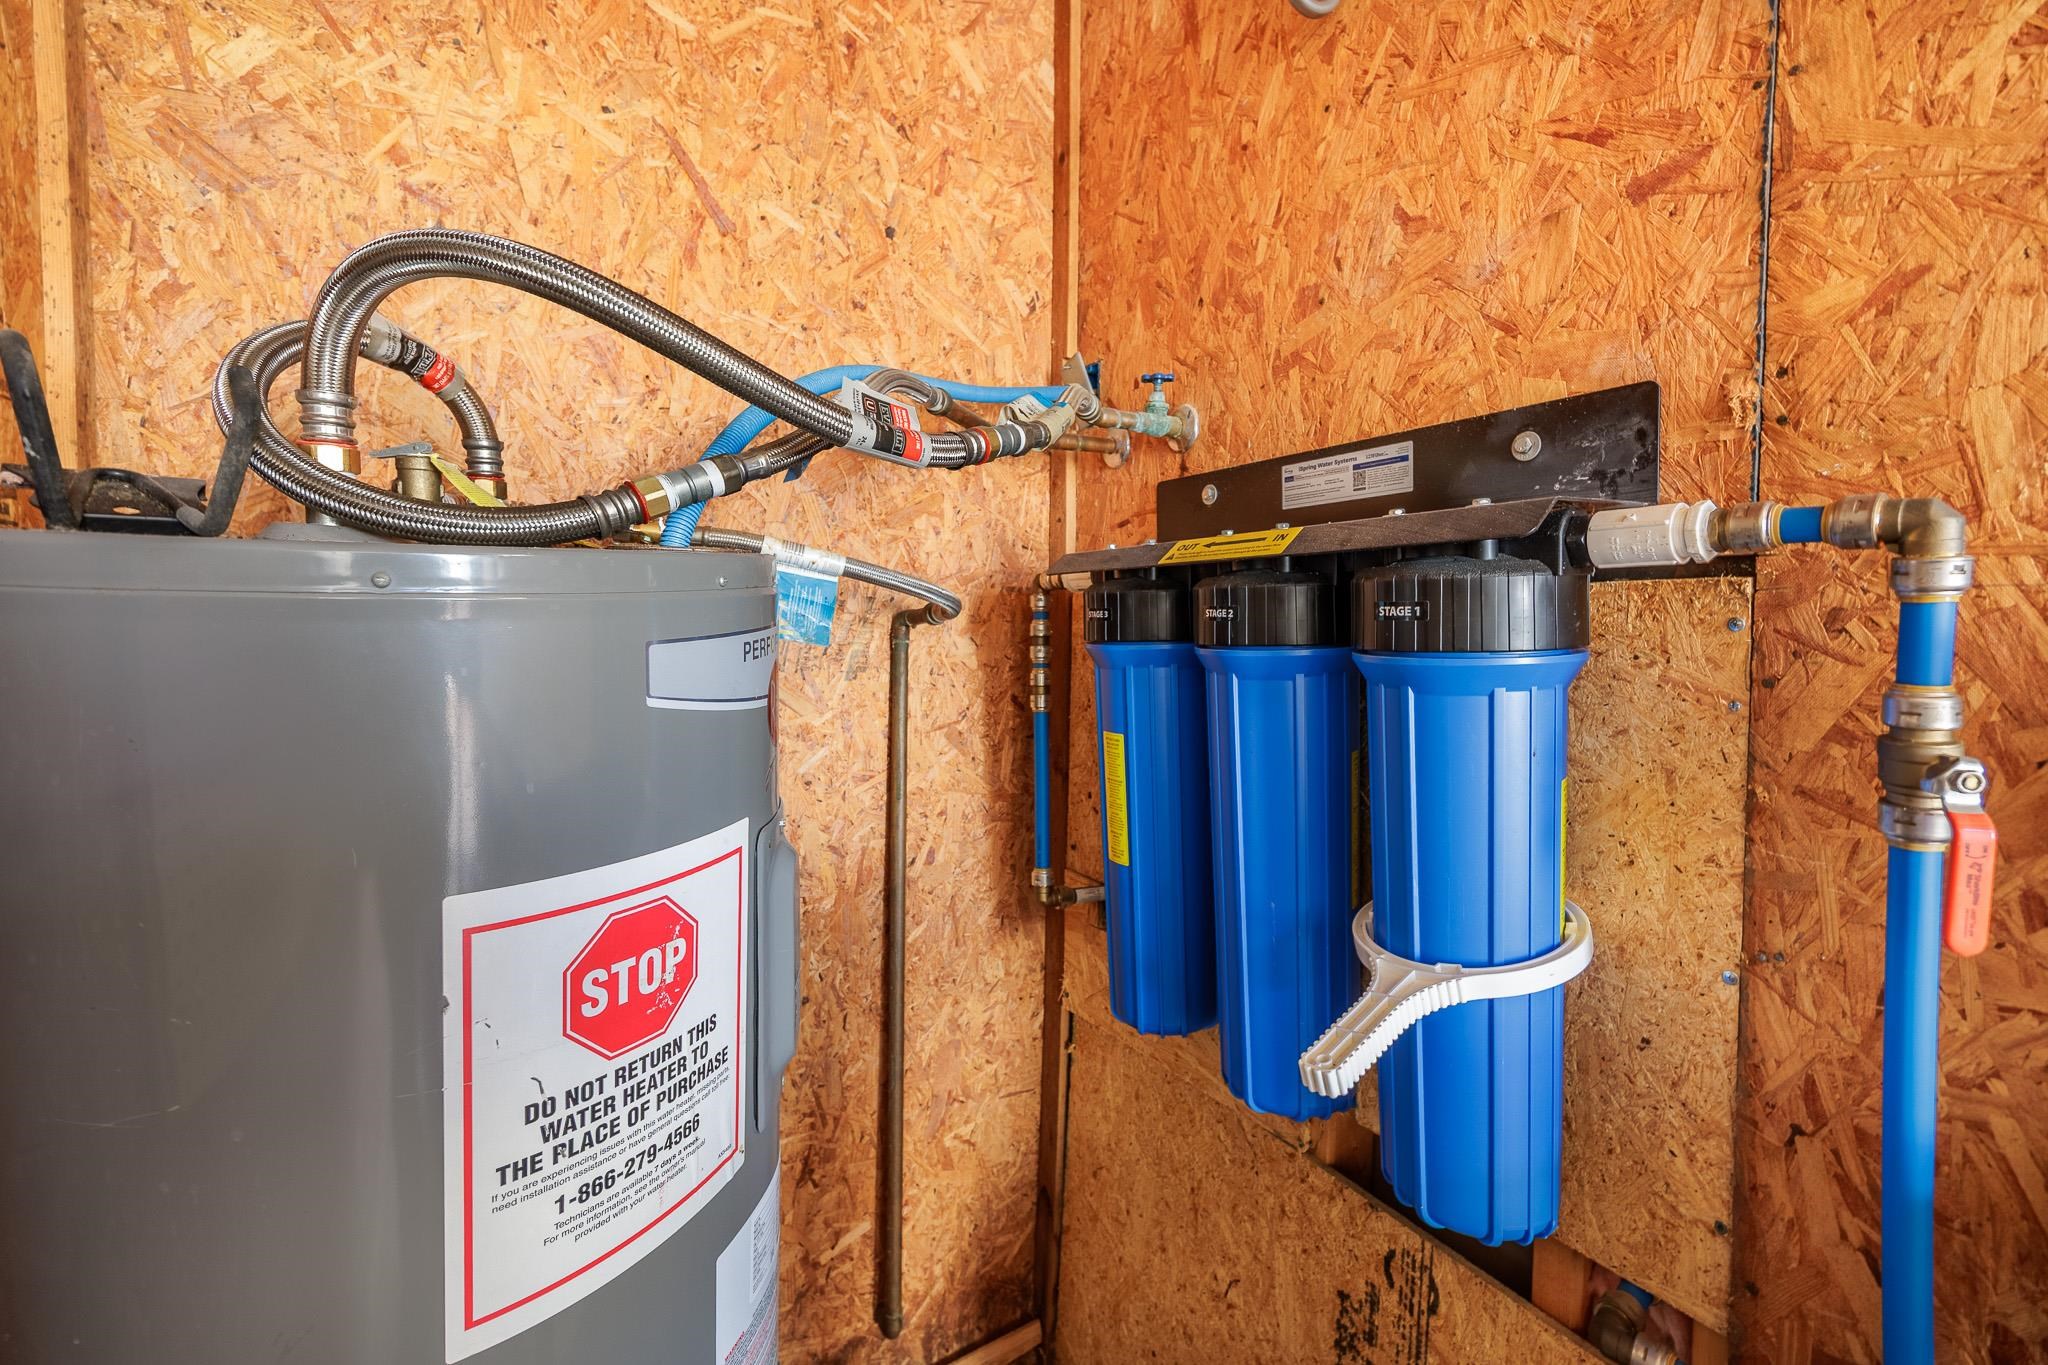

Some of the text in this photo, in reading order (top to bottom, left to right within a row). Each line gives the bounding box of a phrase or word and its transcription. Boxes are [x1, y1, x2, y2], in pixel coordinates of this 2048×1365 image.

[1317, 461, 1334, 470] Water
[1334, 456, 1358, 467] Systems
[1177, 543, 1201, 552] OUT
[1272, 533, 1289, 542] IN
[1088, 610, 1109, 619] STAGE 3
[1205, 608, 1234, 619] STAGE 2
[1378, 606, 1421, 617] STAGE 1
[580, 937, 687, 1018] STOP
[524, 1013, 717, 1126] DO NOT RETURN THIS
[540, 1040, 709, 1144] WATER HEATER TO
[491, 1198, 518, 1214] need
[520, 1176, 571, 1203] installation
[573, 1153, 617, 1180] assistance
[619, 1146, 628, 1155] or
[628, 1138, 643, 1151] have
[647, 1120, 673, 1140] general
[673, 1098, 700, 1121] questions
[701, 1089, 711, 1101] call
[491, 1194, 499, 1203] If
[501, 1187, 520, 1201] you
[522, 1180, 538, 1192] are
[541, 1153, 598, 1183] experiencing
[600, 1138, 625, 1154] issues
[626, 1127, 642, 1141] with
[643, 1119, 656, 1131] this
[657, 1107, 675, 1122] water
[495, 1046, 729, 1187] THE PLACE OF PURCHASE
[543, 1234, 559, 1246] For
[561, 1223, 585, 1238] more
[634, 1184, 648, 1197] see
[649, 1175, 660, 1188] the
[661, 1157, 685, 1180] owner's
[685, 1138, 706, 1158] manual
[553, 1201, 605, 1230] Technicians
[606, 1193, 620, 1204] are
[621, 1170, 654, 1198] available
[654, 1164, 659, 1172] 7
[660, 1153, 677, 1169] days
[683, 1136, 701, 1152] week.
[554, 1113, 700, 1215] 1-866-279-4566
[574, 1214, 611, 1243] provided
[612, 1205, 629, 1219] with
[629, 1194, 647, 1211] your
[647, 1181, 664, 1197] water
